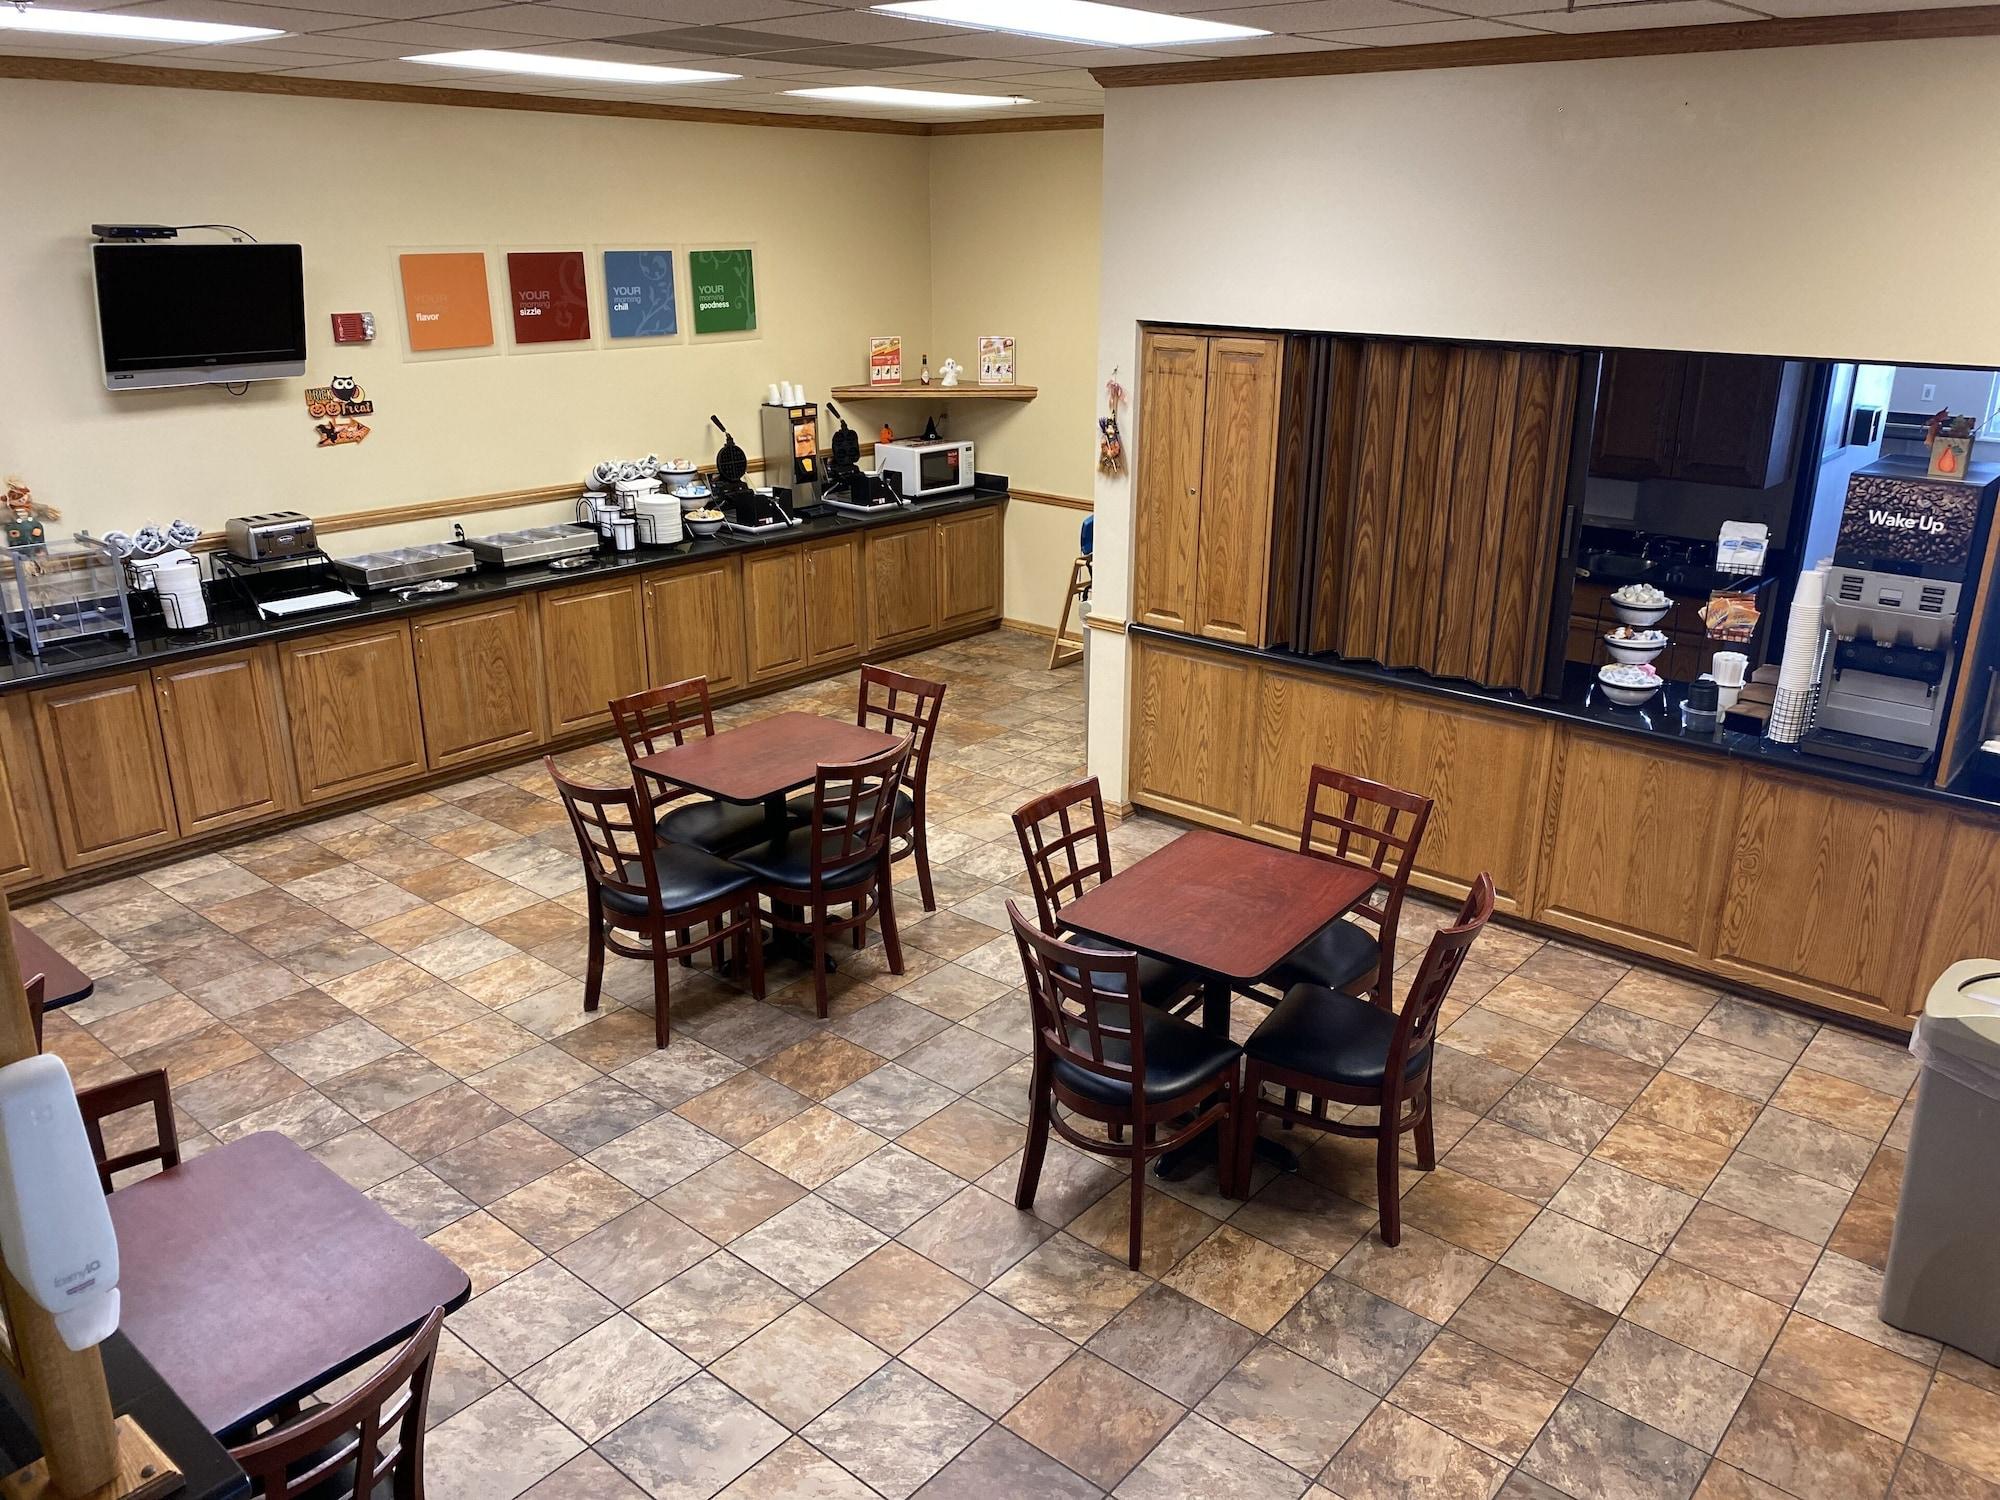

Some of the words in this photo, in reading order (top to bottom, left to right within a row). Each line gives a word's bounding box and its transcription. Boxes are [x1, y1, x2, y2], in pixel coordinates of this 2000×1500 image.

[613, 286, 641, 295] YOUR
[698, 285, 725, 294] YOUR
[518, 290, 550, 300] YOUR
[613, 303, 629, 311] chill
[699, 301, 730, 311] goodness
[519, 307, 542, 316] sizzle
[415, 312, 440, 321] flavor
[1868, 509, 1916, 529] Wake
[1919, 515, 1945, 535] Up
